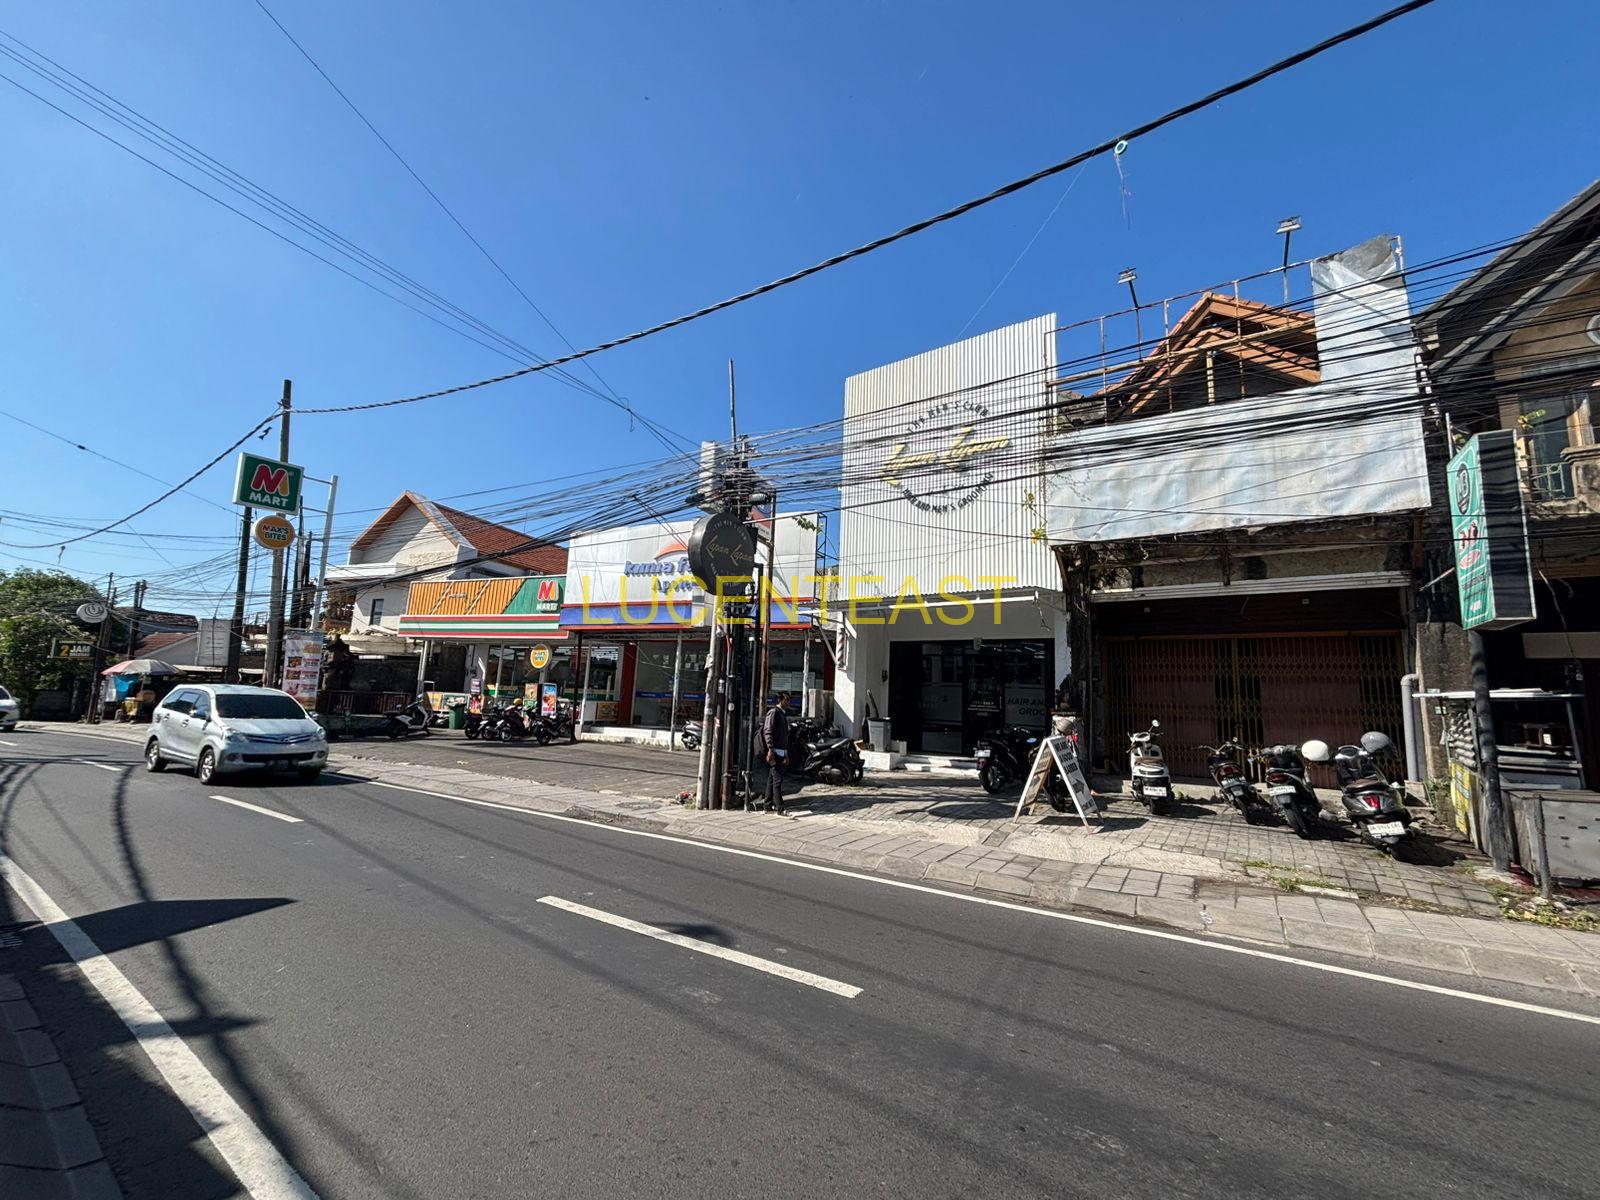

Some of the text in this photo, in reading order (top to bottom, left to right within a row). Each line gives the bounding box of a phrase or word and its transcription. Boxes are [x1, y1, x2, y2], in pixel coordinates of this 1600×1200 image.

[249, 491, 289, 507] MART
[262, 524, 290, 534] MAX'S
[264, 531, 288, 541] BITES
[60, 645, 70, 657] 2
[70, 645, 91, 653] JAM
[1007, 697, 1028, 705] HAIR
